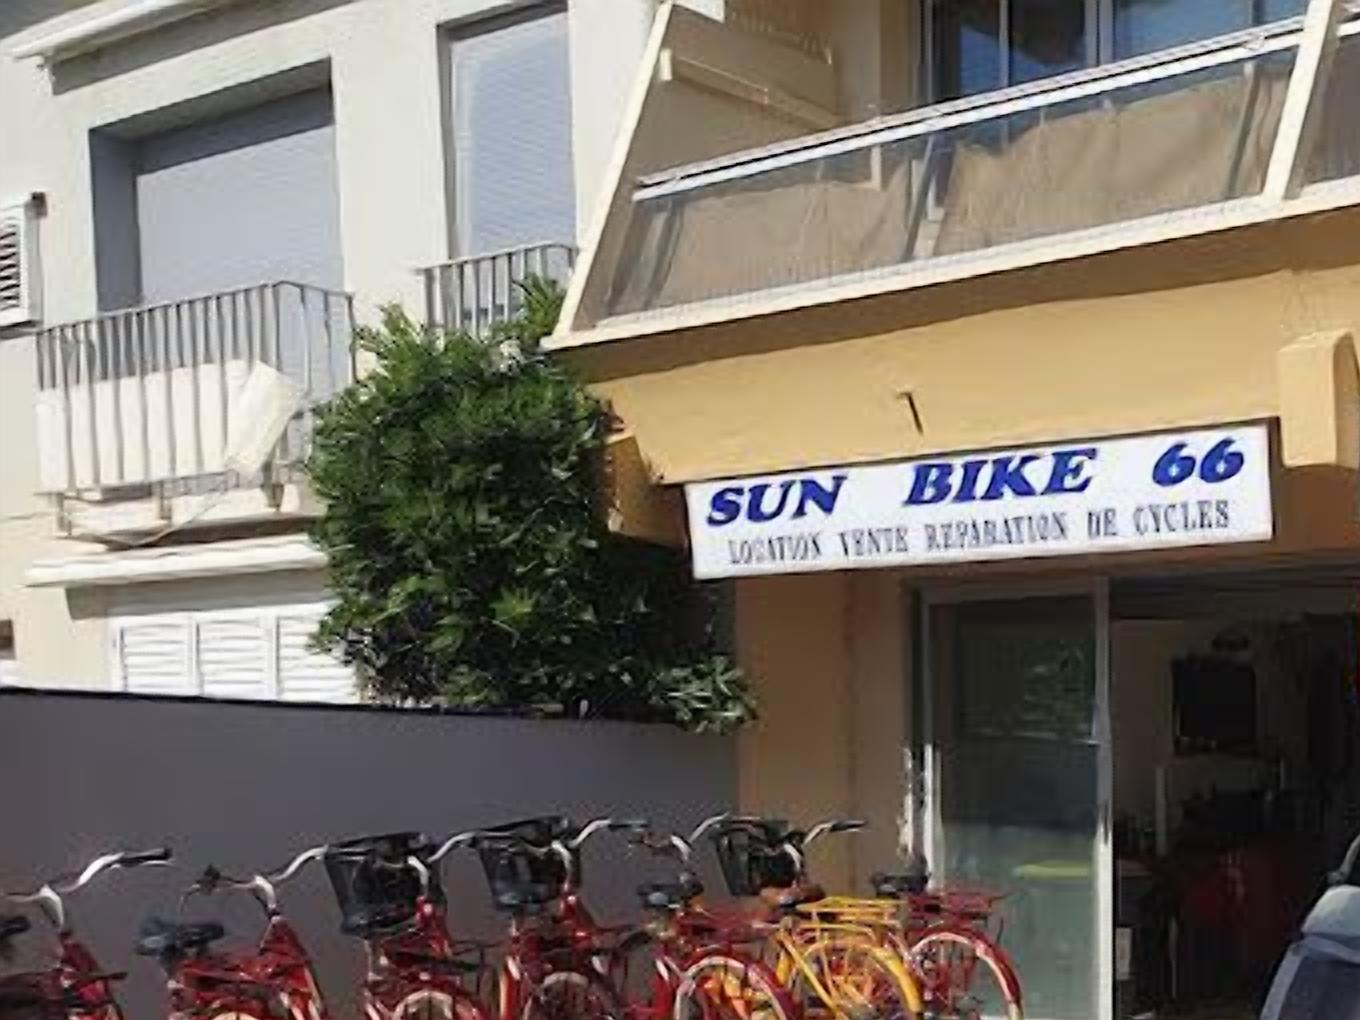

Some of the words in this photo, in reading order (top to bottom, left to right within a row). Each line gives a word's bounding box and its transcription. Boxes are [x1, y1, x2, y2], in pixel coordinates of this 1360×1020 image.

[706, 474, 849, 527] SUN
[901, 448, 1098, 506] BIKE
[1151, 438, 1245, 487] 66
[727, 531, 822, 566] LOCATION
[838, 526, 910, 559] VENTE
[1086, 508, 1118, 539] DE
[1132, 499, 1231, 537] CYCLES
